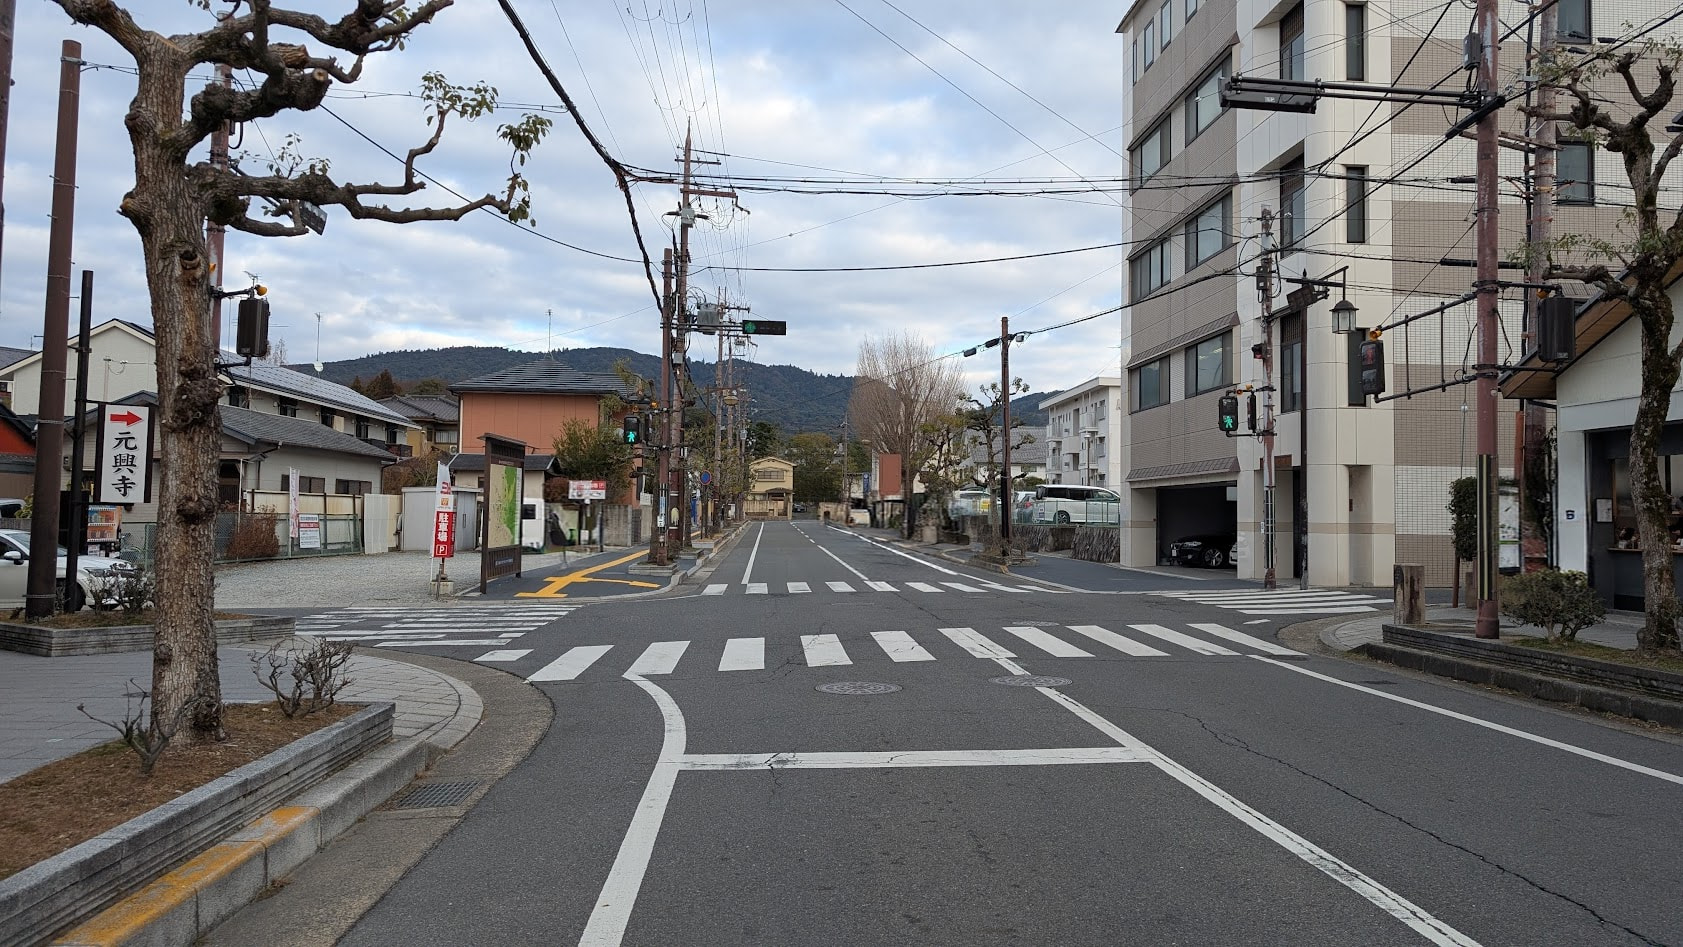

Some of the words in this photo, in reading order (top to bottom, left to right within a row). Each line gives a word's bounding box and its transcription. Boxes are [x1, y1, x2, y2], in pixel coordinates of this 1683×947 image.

[111, 431, 138, 497] 元興寺
[438, 512, 449, 542] 駐車場
